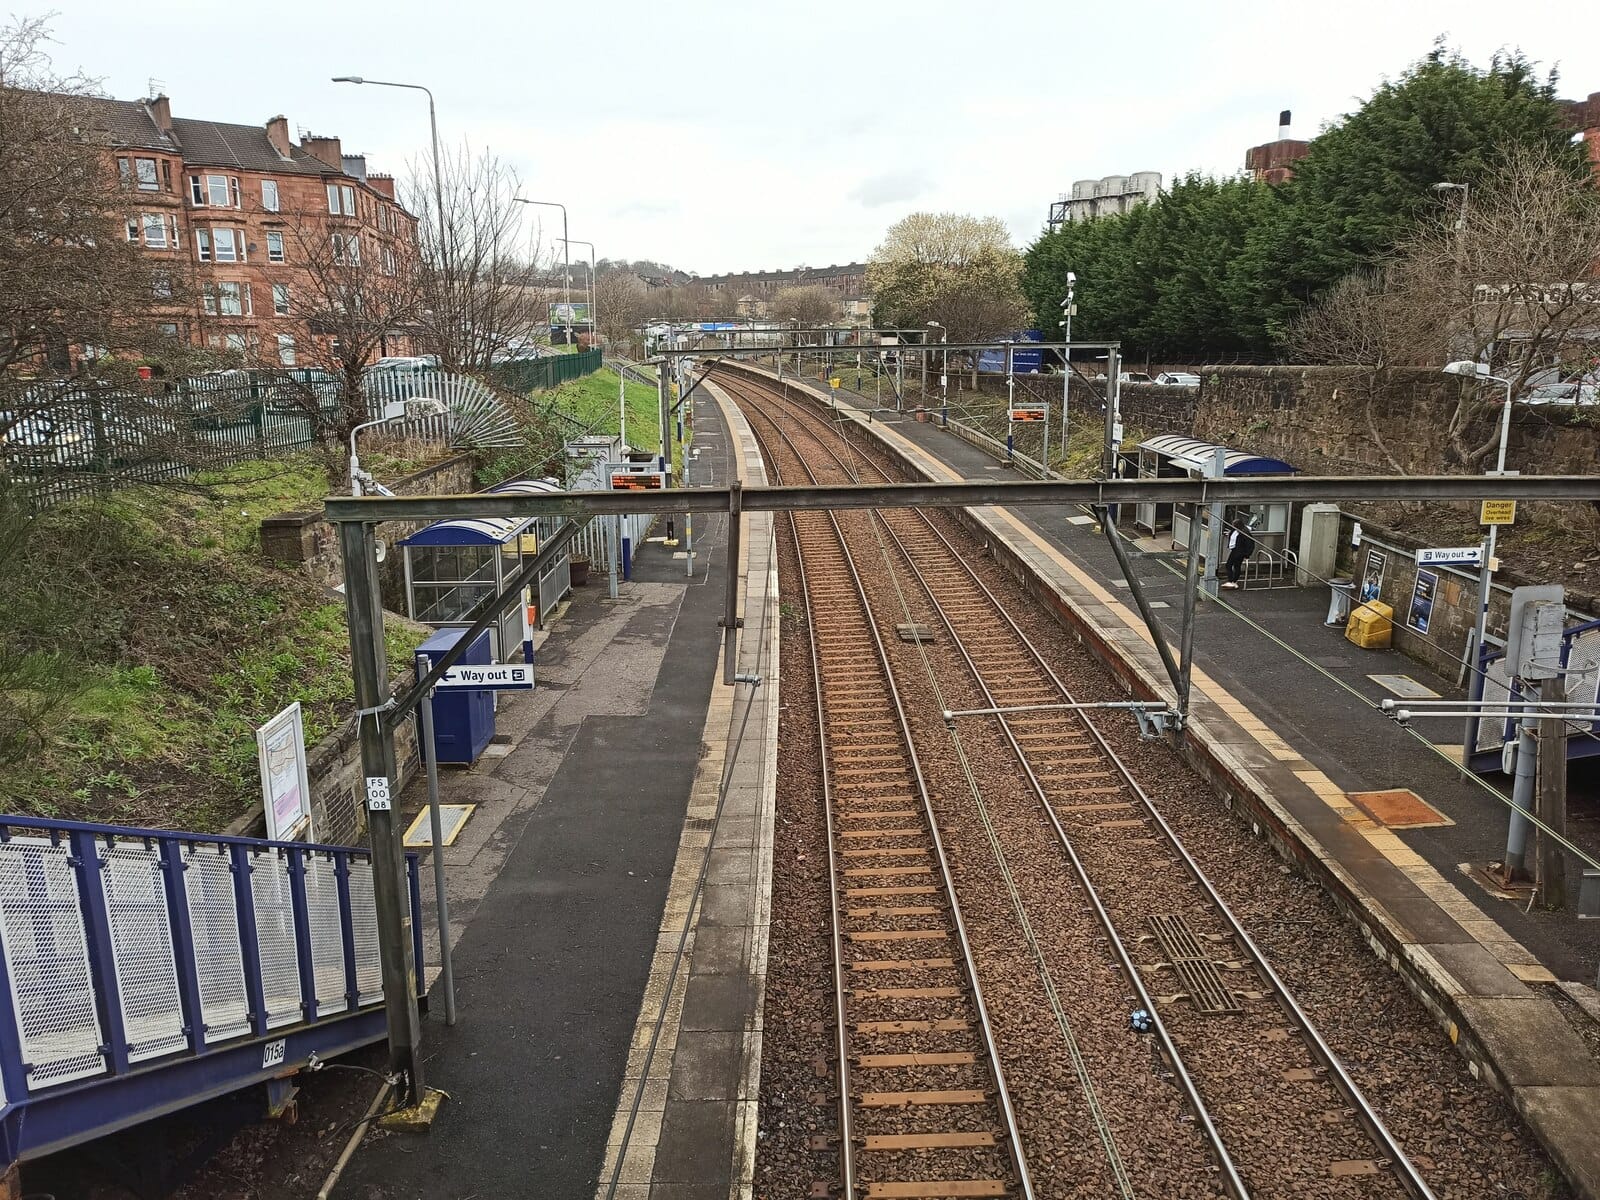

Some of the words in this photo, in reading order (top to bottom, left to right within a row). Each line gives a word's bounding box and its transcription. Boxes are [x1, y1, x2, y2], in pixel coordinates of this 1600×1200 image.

[1434, 551, 1450, 560] Way
[460, 670, 485, 683] Way
[487, 670, 508, 680] out
[371, 778, 384, 787] FS
[373, 801, 387, 809] 08
[264, 1043, 284, 1063] 015a
